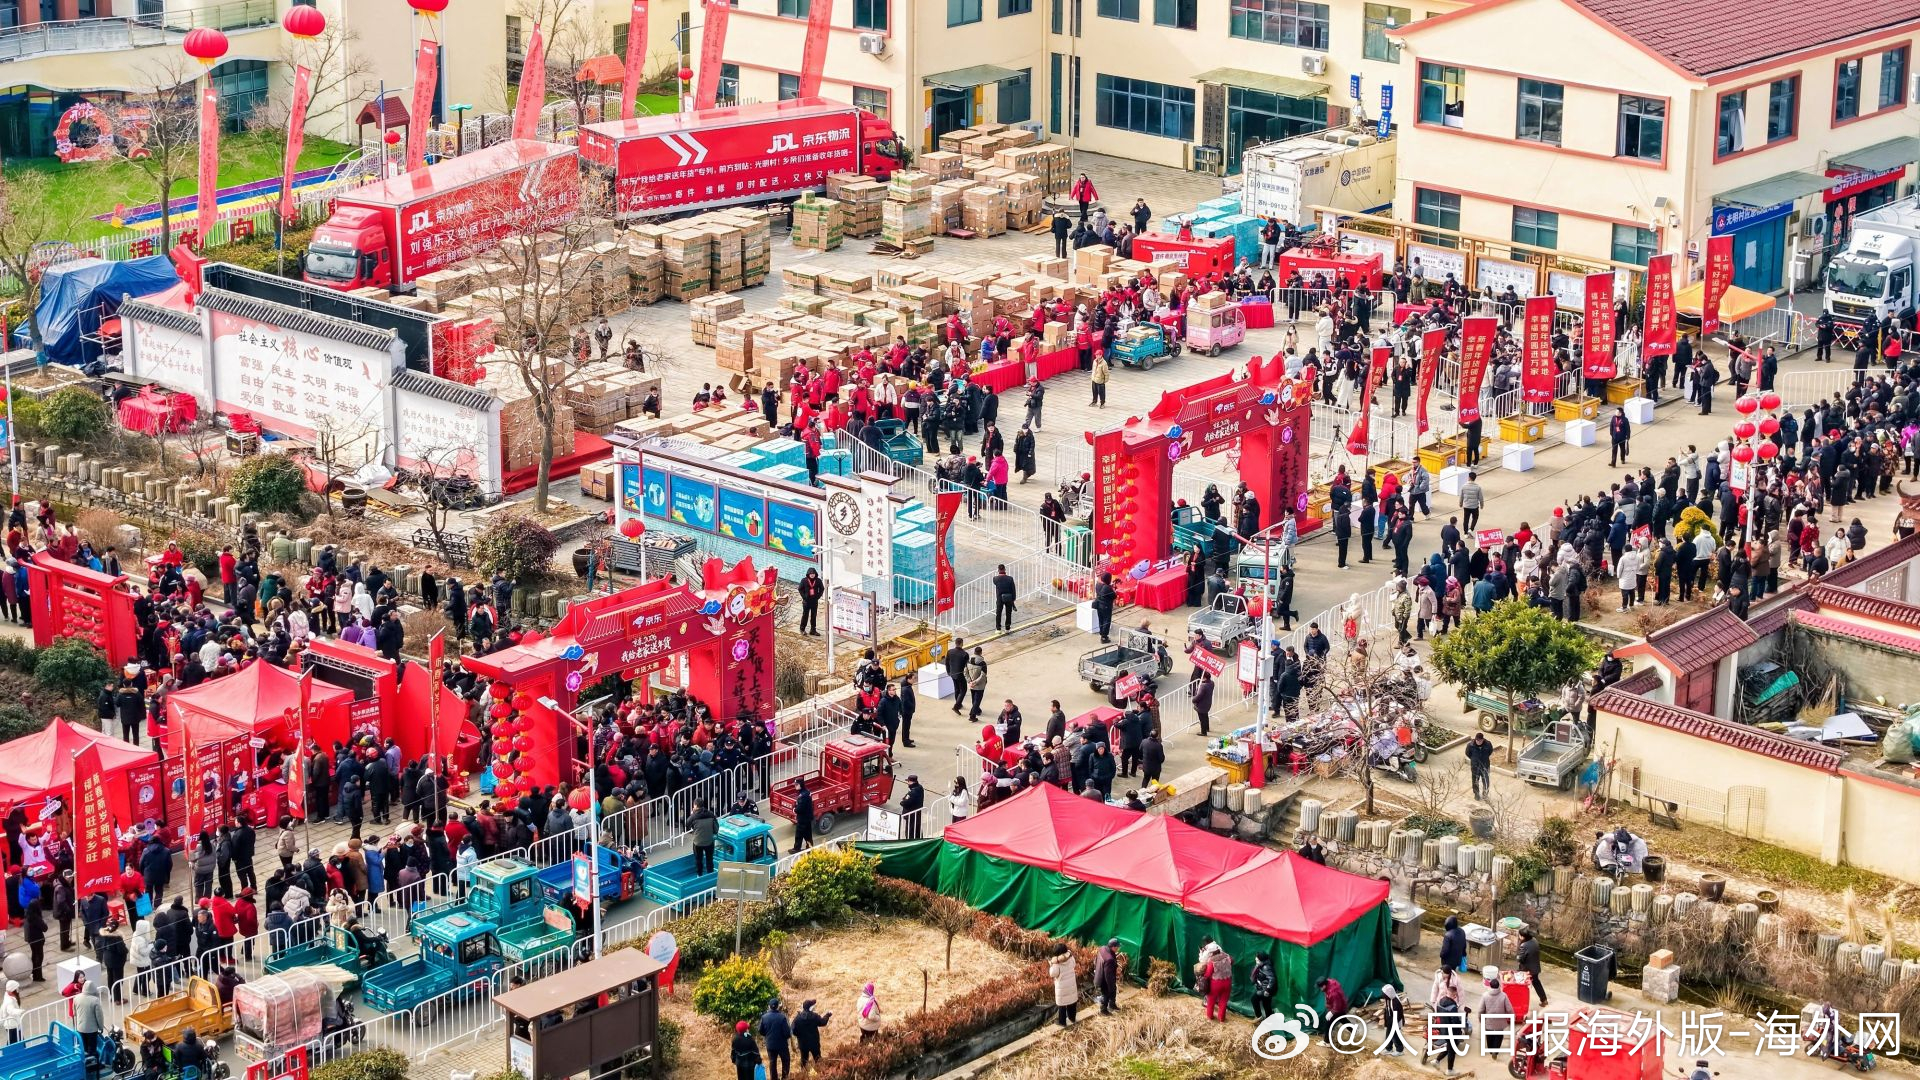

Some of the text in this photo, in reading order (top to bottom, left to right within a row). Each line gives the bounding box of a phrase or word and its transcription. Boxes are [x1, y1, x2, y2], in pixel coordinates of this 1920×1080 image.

[766, 128, 850, 154] JDL 京东物流
[408, 210, 433, 235] JDL
[239, 356, 360, 398] 富强 民主 文明 和谐
[240, 374, 361, 416] 自由 平等 公正 法治
[240, 390, 264, 407] 爱国
[272, 400, 298, 416] 敬业
[1102, 455, 1112, 524] 幸福团圆进万家
[645, 614, 662, 626] 京东
[84, 776, 98, 864] 福旺财旺家乡旺
[92, 772, 112, 860] 新春新岁新气象
[94, 874, 112, 886] 京东
